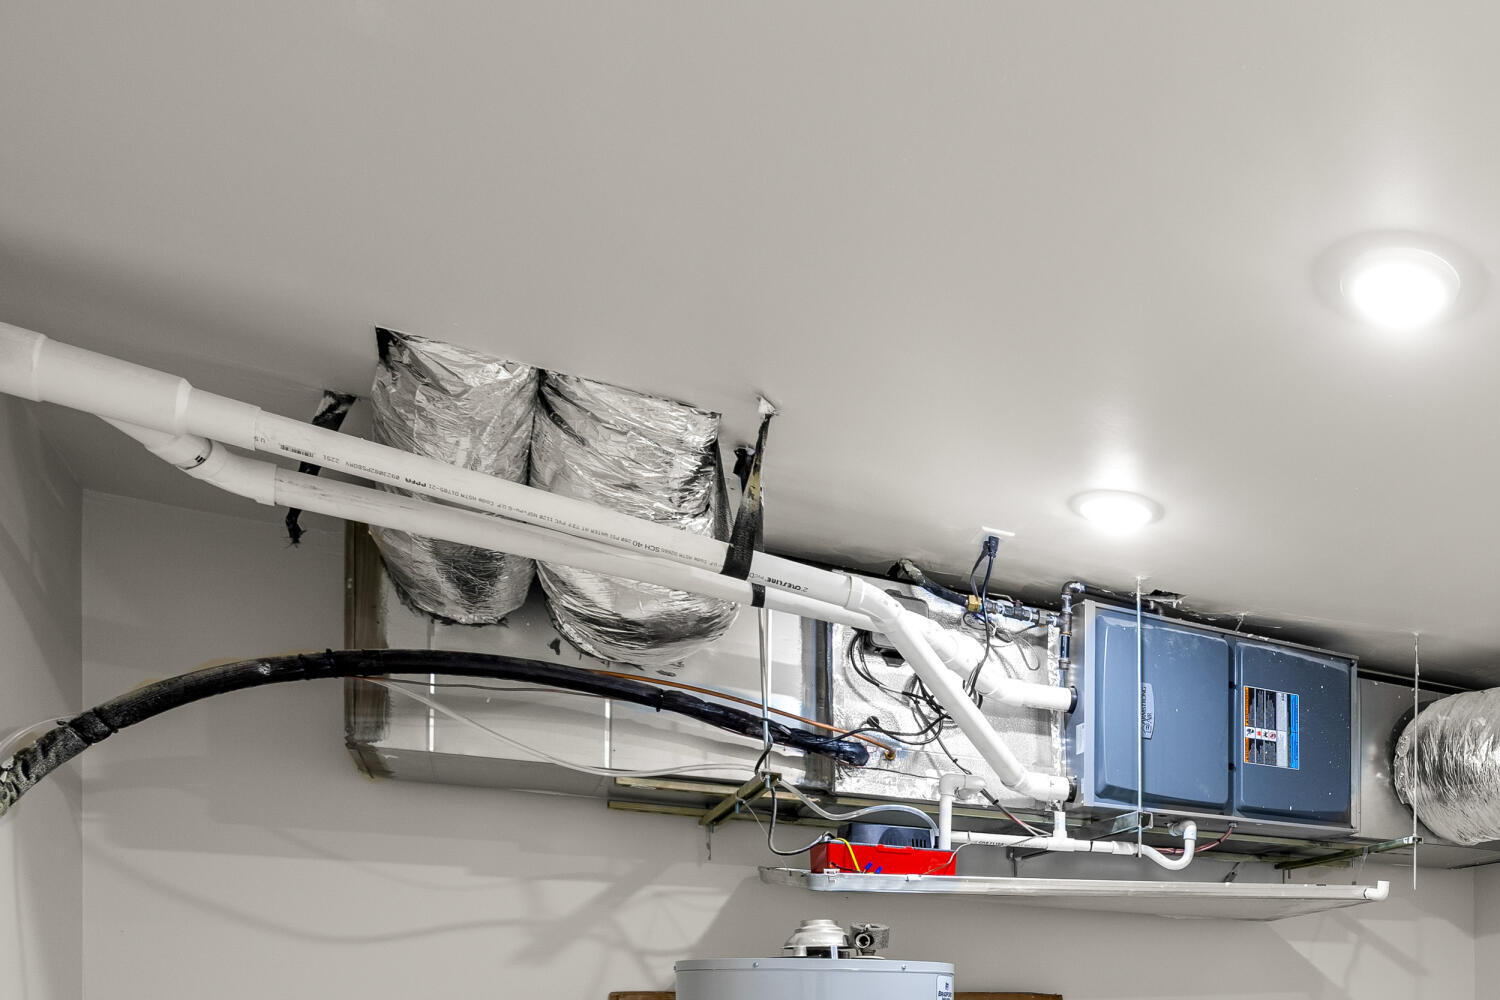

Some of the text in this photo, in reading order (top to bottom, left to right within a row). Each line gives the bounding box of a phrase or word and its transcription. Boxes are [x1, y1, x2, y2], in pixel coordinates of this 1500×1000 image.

[404, 476, 427, 488] PPFA
[631, 539, 643, 548] 40
[643, 543, 661, 553] SCH
[765, 576, 802, 591] CRESLINE
